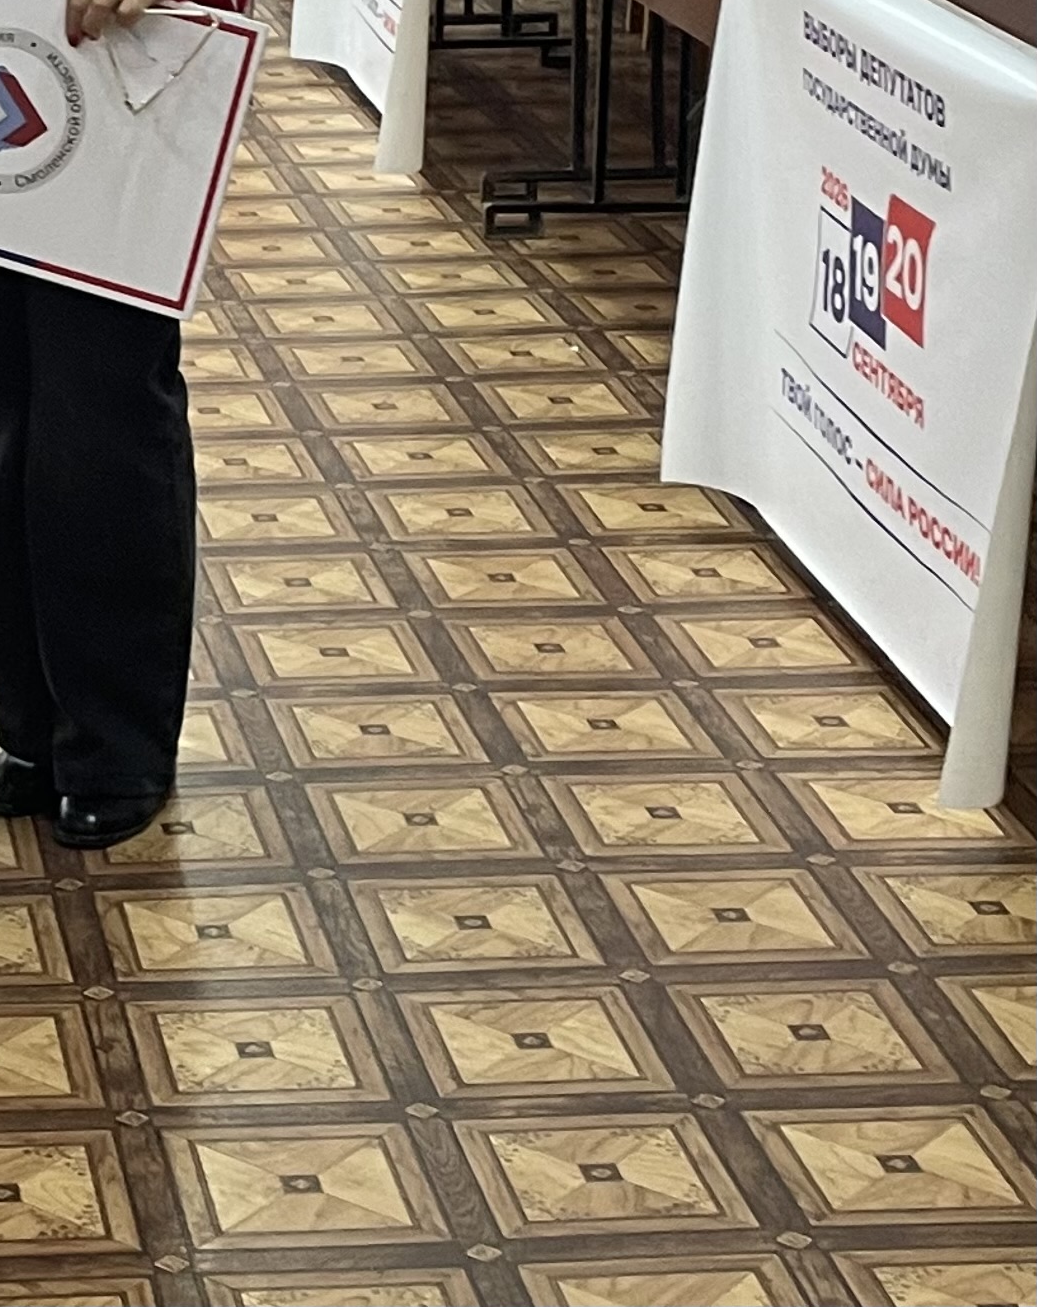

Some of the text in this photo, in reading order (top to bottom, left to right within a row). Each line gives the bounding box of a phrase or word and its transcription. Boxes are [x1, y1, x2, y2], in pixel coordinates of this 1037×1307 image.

[860, 48, 946, 128] ДЕПУТАТОВ
[822, 248, 846, 324] 18
[852, 234, 879, 312] 19
[885, 224, 924, 311] 20
